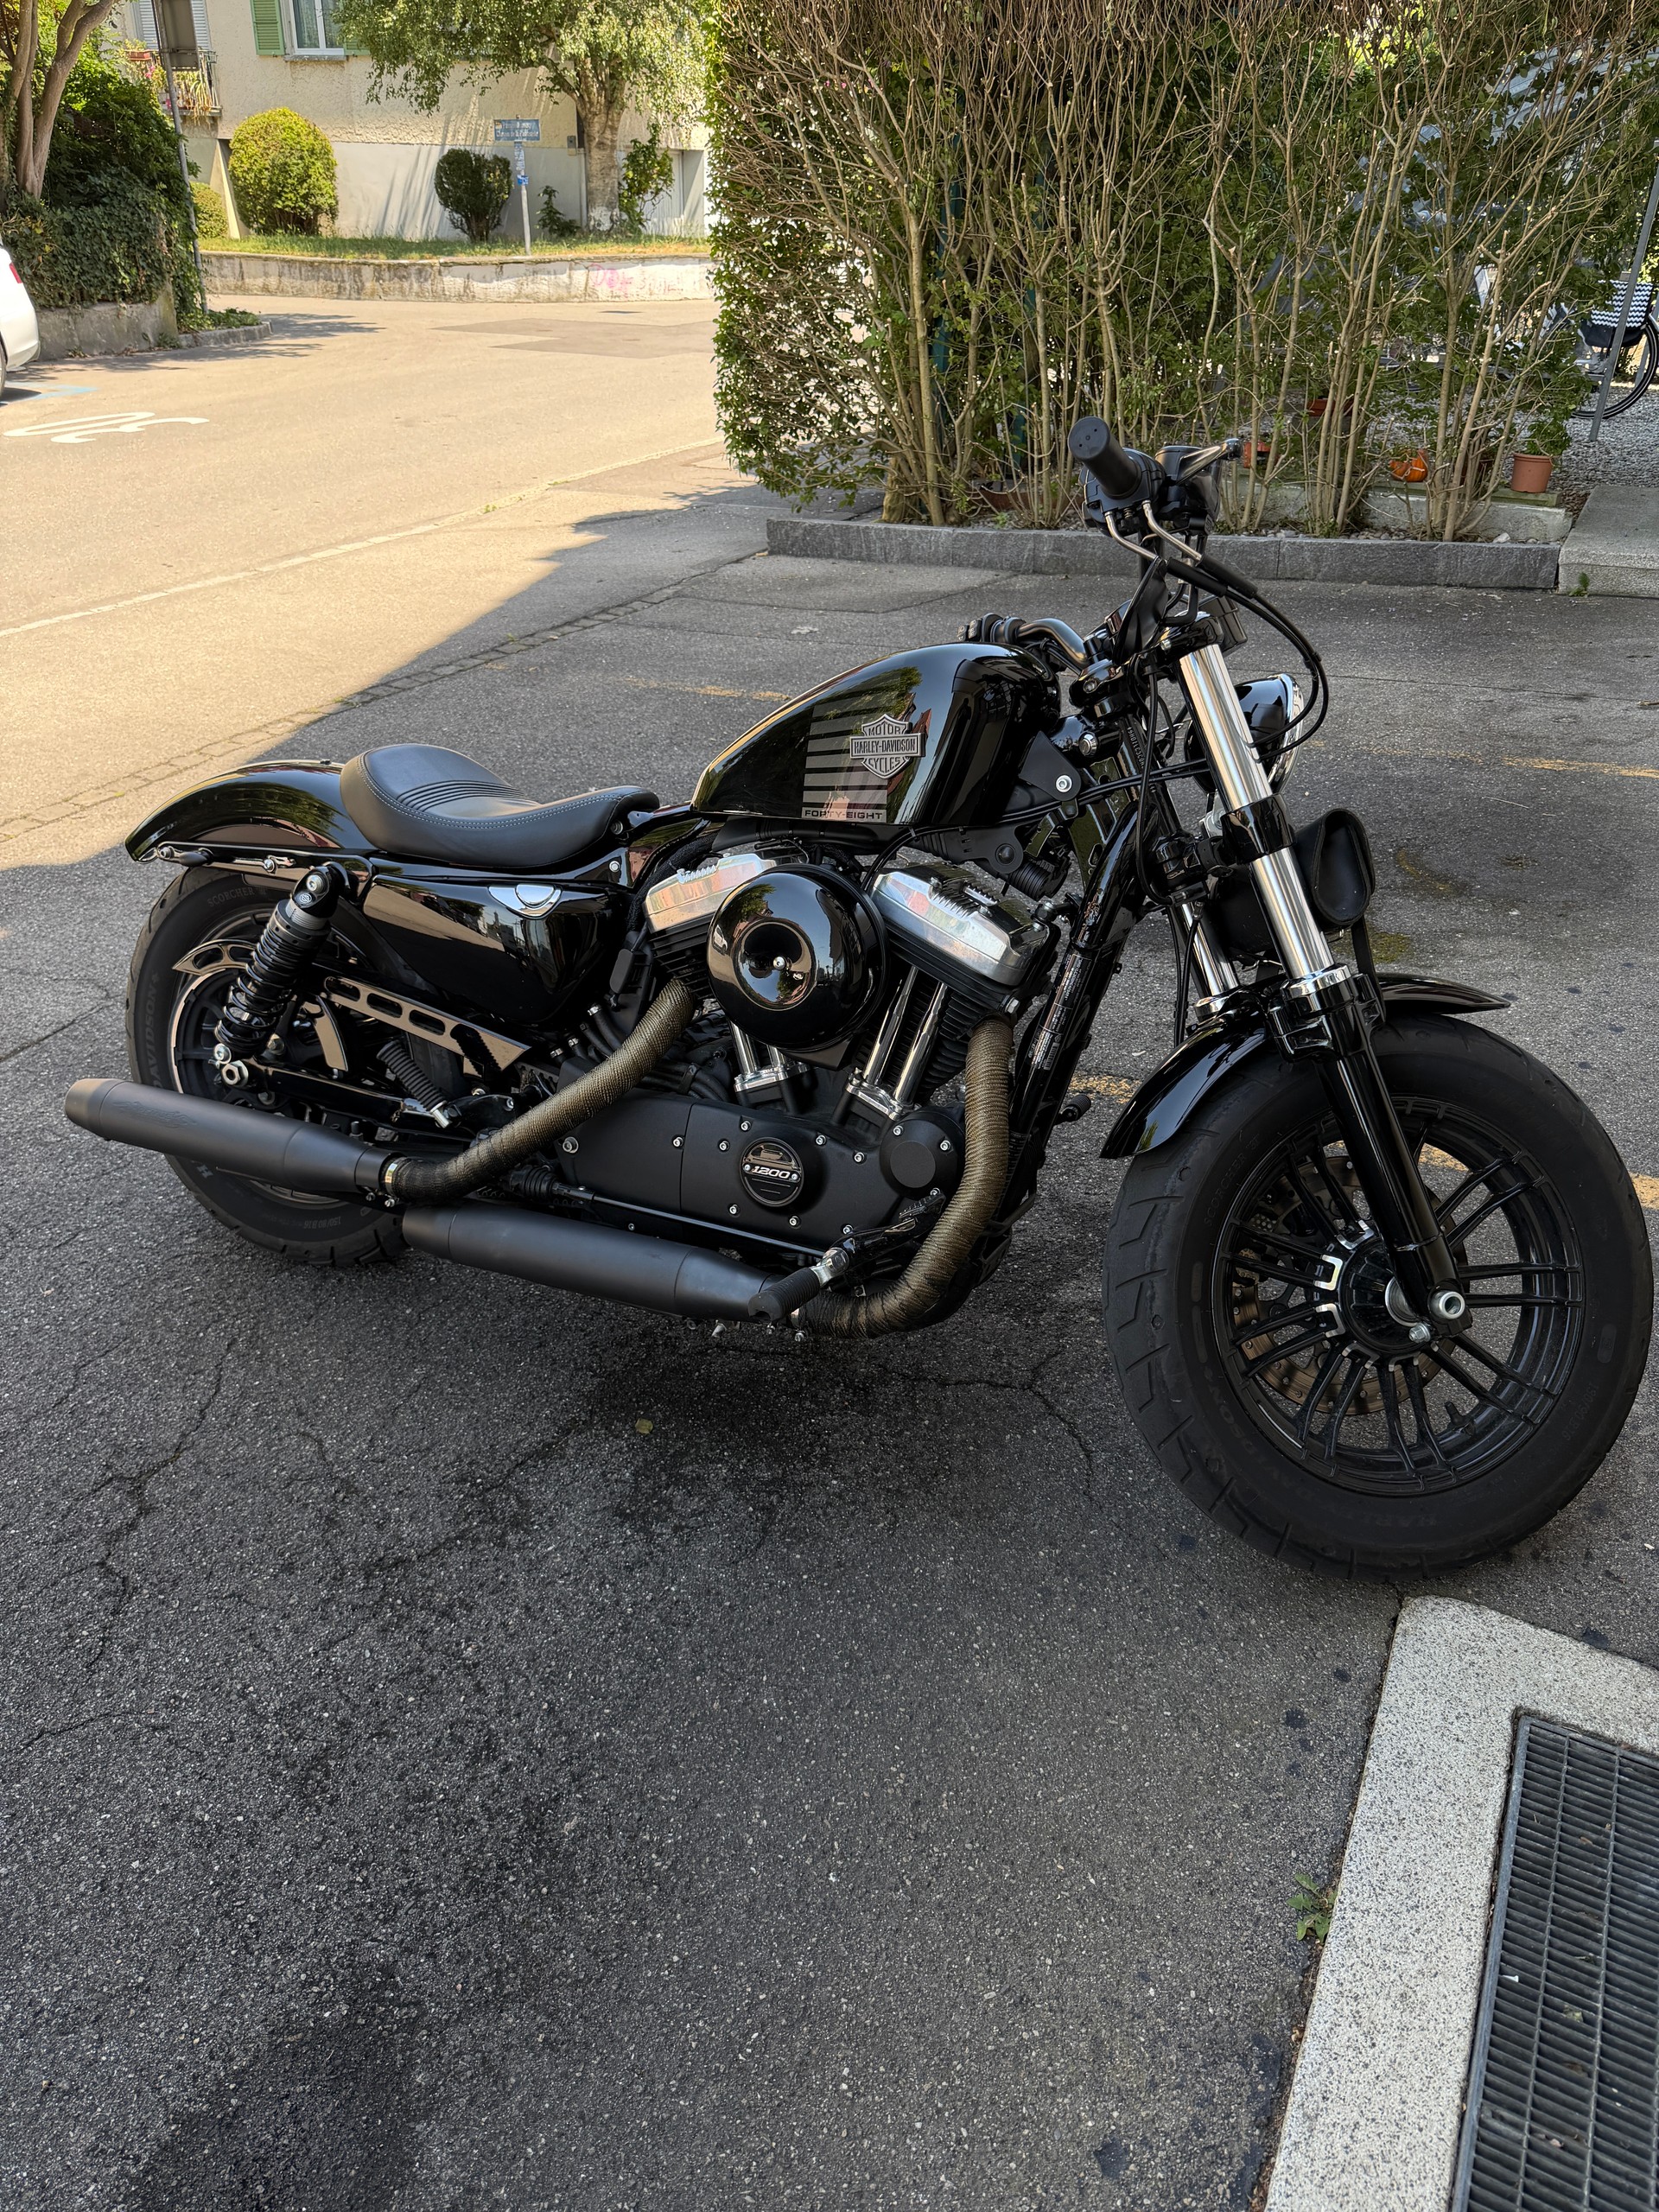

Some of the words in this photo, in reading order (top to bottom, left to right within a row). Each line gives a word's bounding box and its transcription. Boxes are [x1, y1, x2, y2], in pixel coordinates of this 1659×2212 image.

[868, 721, 901, 736] MOTOR
[854, 738, 916, 754] HARLEY-DAVIDSON
[868, 757, 901, 773] CYCLES
[804, 810, 883, 820] FORTY-EIGHT
[207, 887, 256, 907] SCORCHER
[752, 1166, 791, 1179] 1200
[1202, 1151, 1248, 1226] SCORCHER
